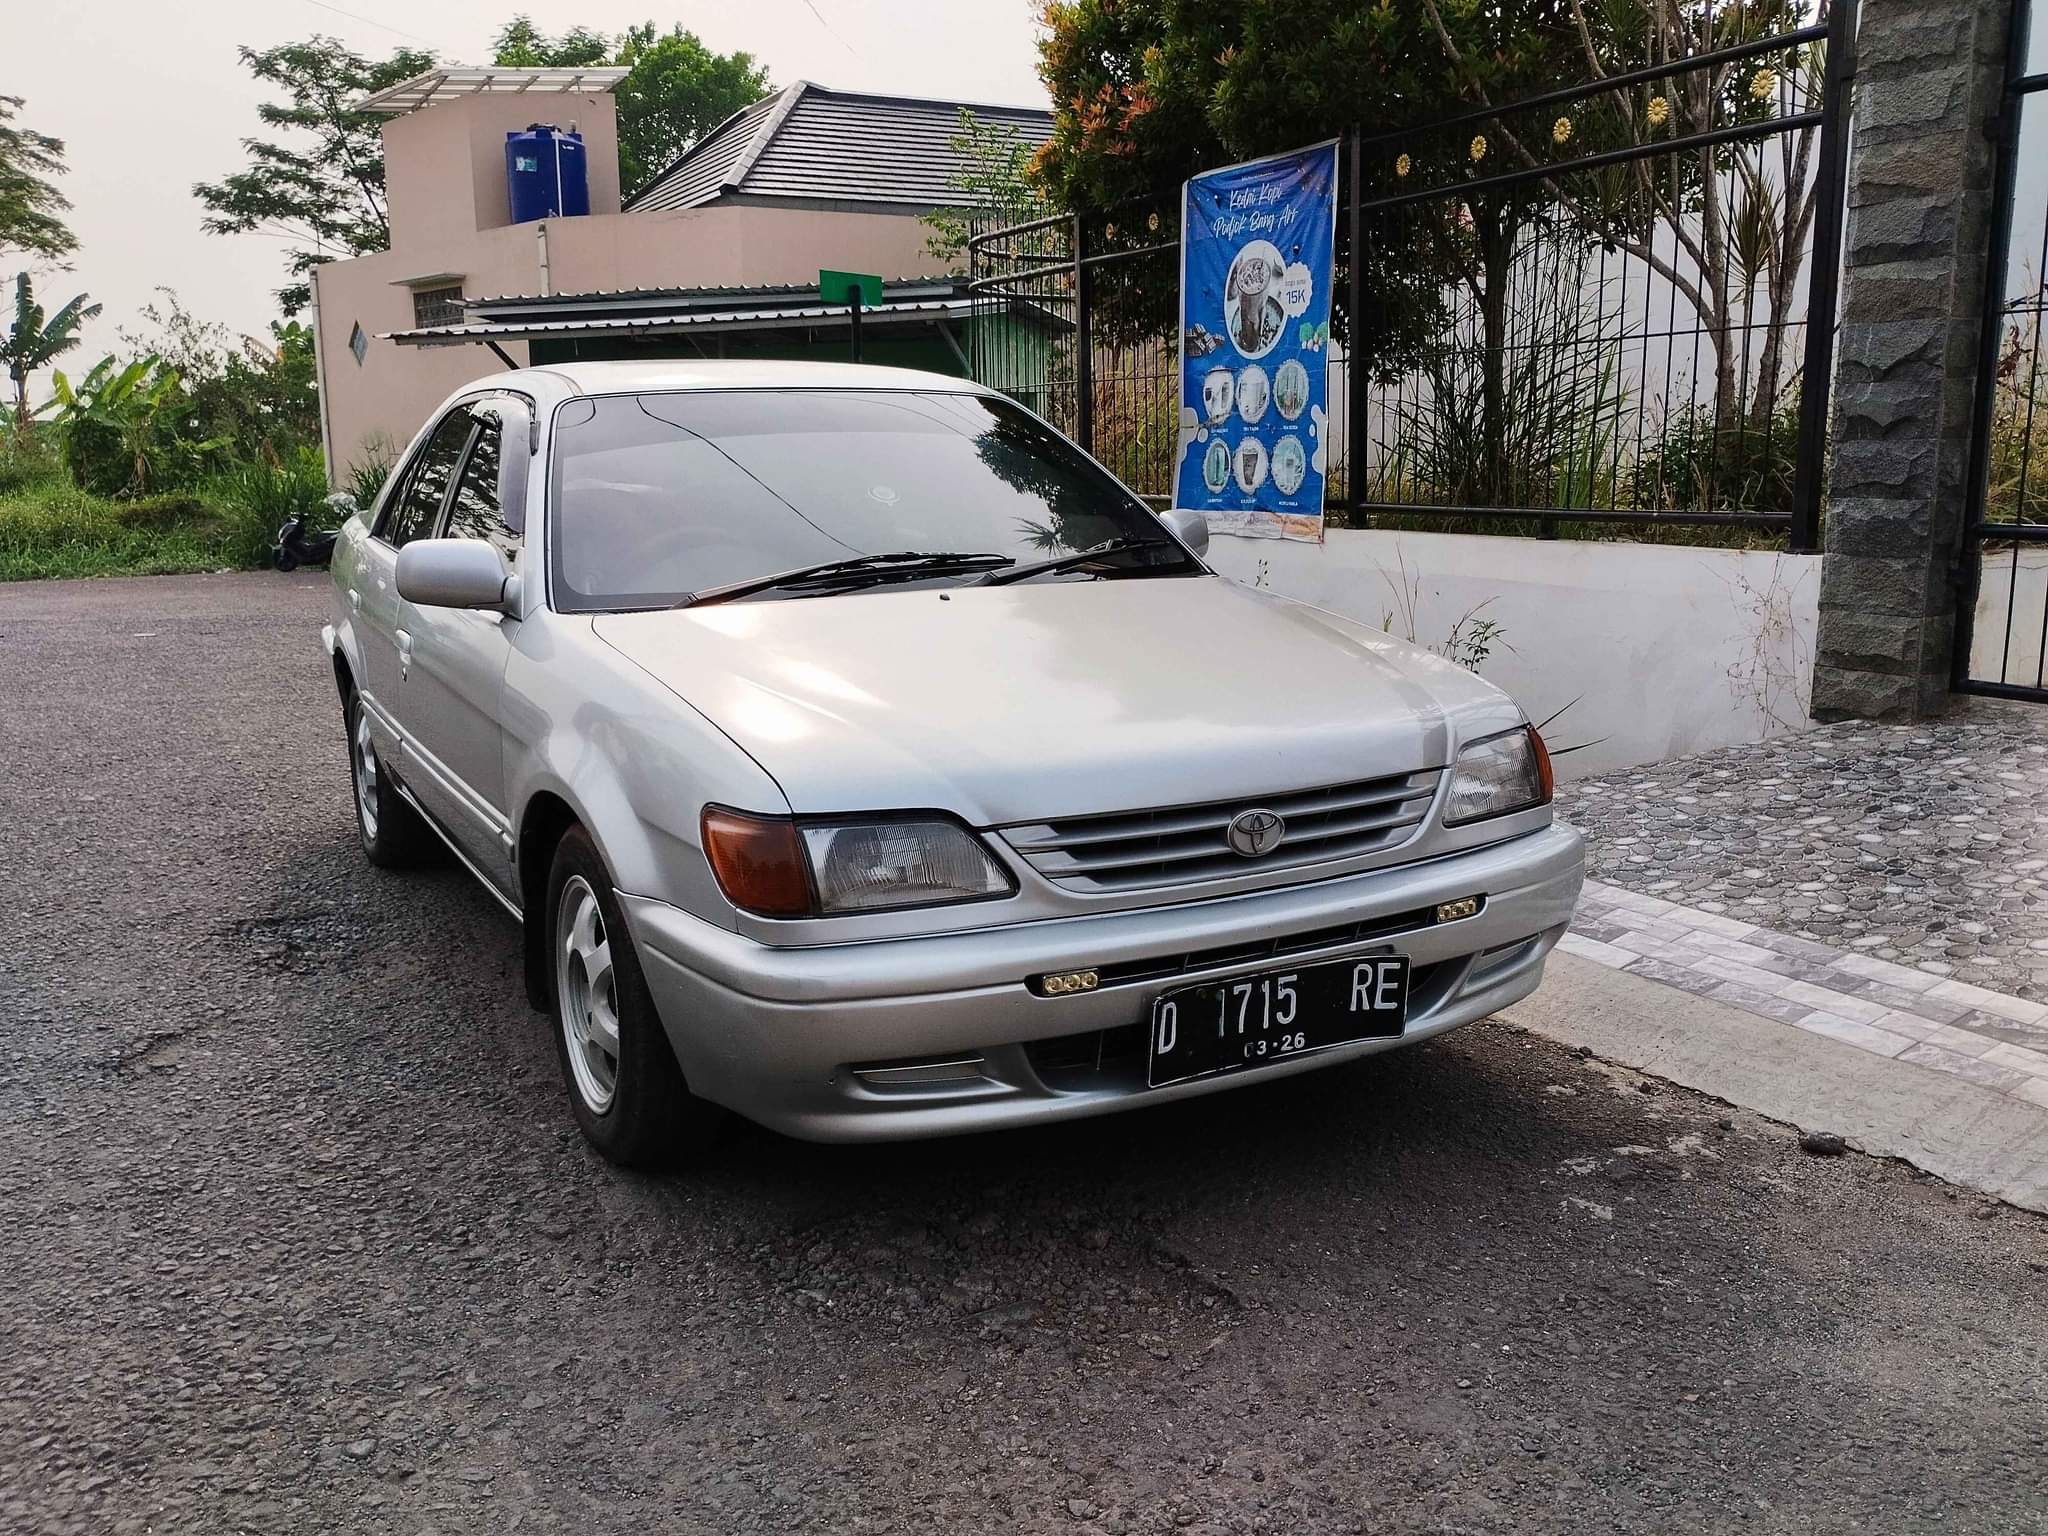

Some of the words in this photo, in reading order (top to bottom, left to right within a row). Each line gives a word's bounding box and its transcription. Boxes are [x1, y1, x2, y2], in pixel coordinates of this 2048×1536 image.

[1258, 183, 1283, 206] Kopi
[1249, 211, 1275, 232] Bang
[1286, 289, 1306, 304] 15K
[1157, 1001, 1177, 1055] D
[1218, 974, 1298, 1039] 1715
[1349, 962, 1401, 1012] RE
